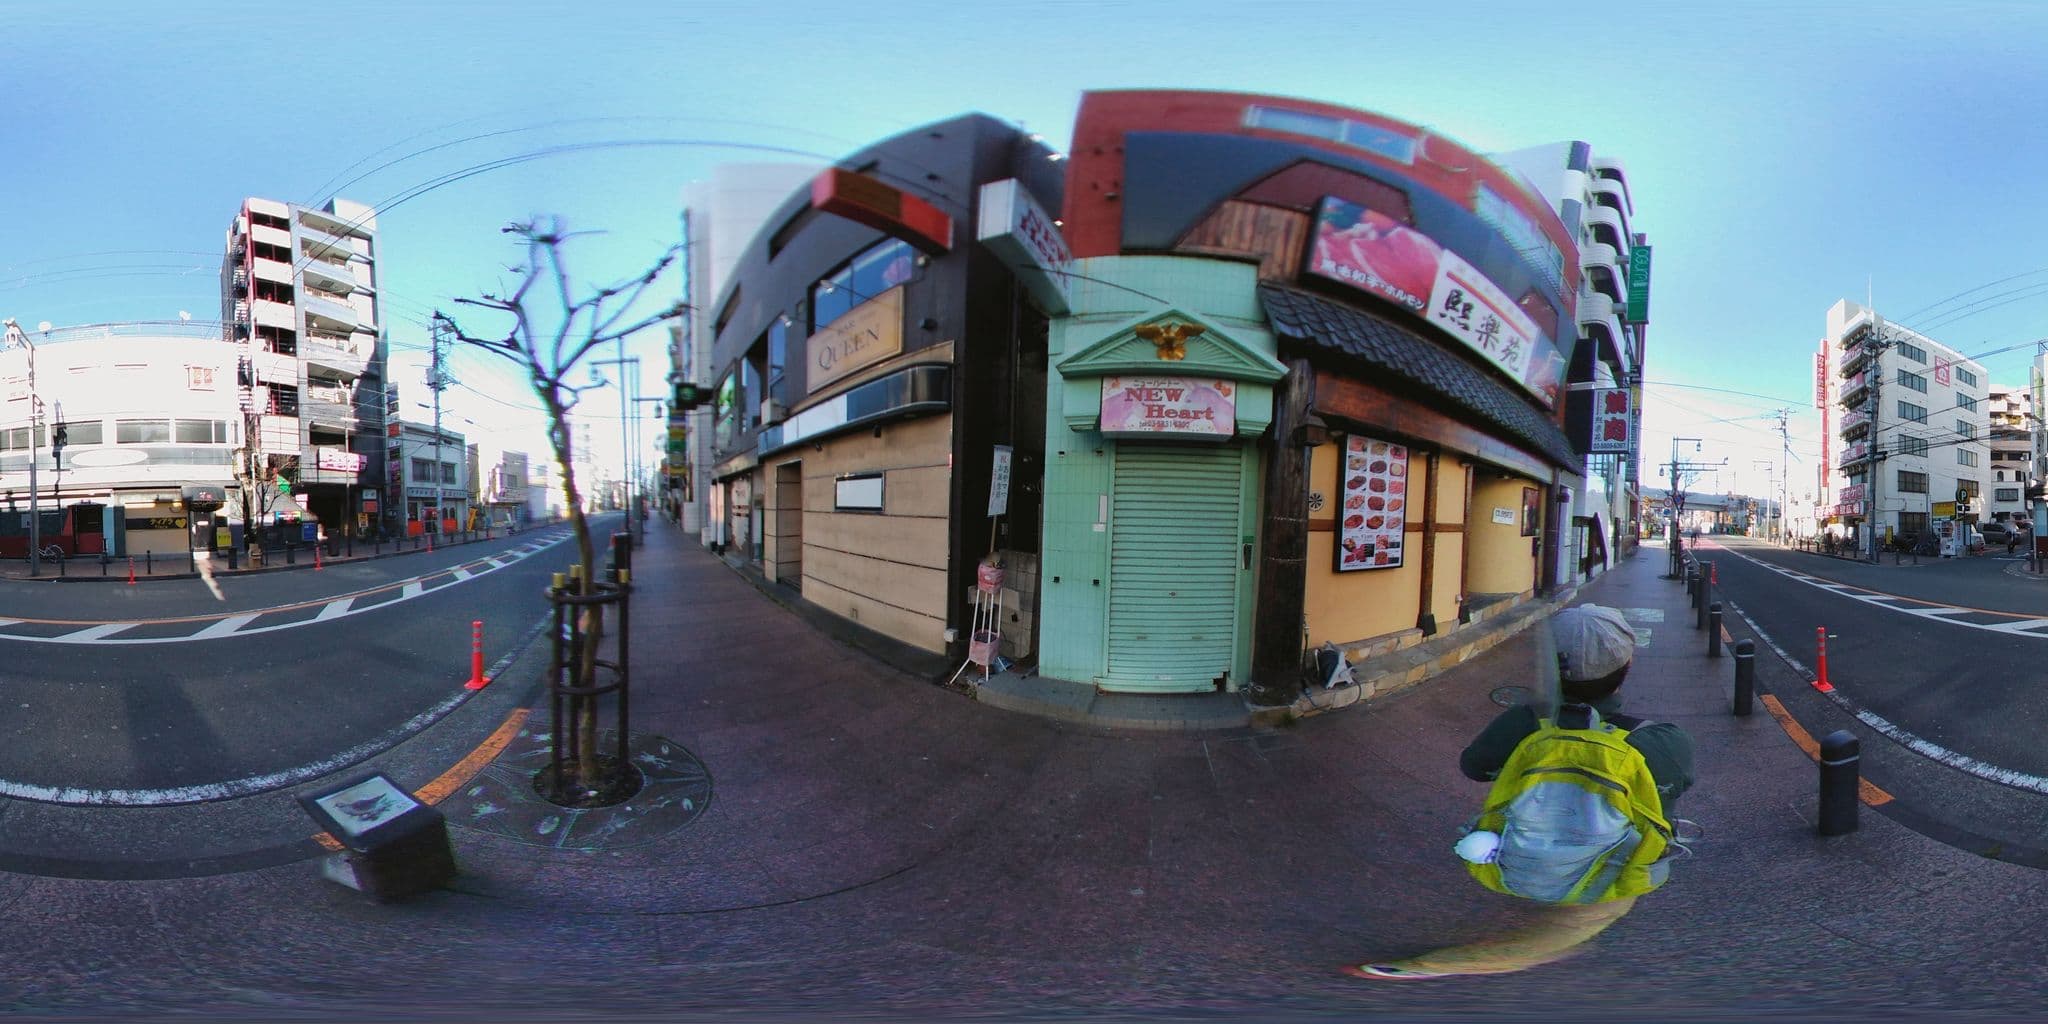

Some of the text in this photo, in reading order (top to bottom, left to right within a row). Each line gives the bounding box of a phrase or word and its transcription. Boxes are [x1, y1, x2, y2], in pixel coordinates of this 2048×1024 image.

[819, 324, 880, 370] QUEEN
[1124, 387, 1185, 402] NEW
[1145, 403, 1215, 420] Heart
[1961, 490, 1968, 500] P
